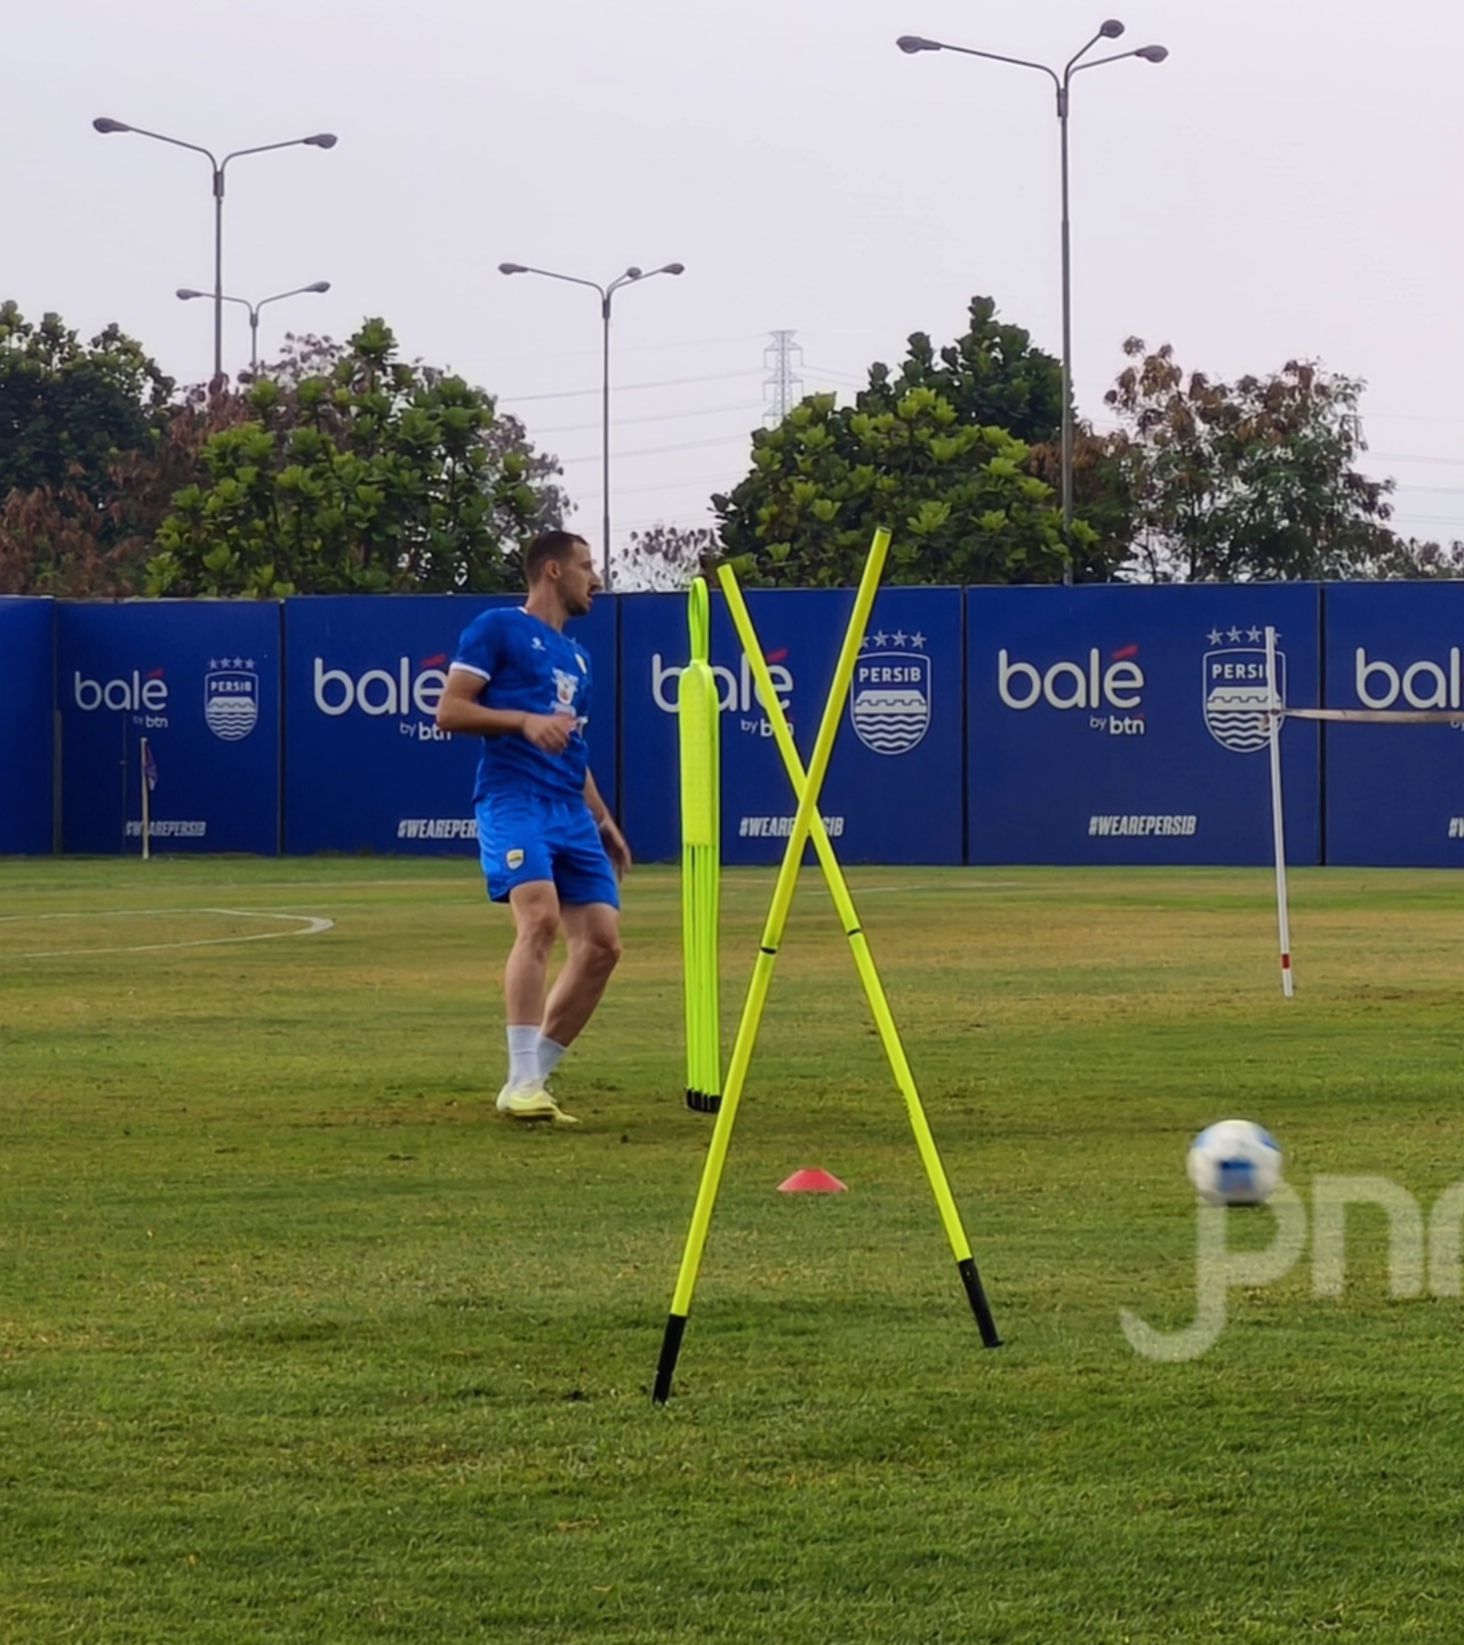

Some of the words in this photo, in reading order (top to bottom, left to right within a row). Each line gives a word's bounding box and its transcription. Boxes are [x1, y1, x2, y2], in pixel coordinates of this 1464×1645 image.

[858, 666, 922, 683] PERSIB
[998, 644, 1144, 710] balé
[1212, 663, 1268, 680] PERSI
[74, 667, 168, 711] balé
[210, 681, 252, 692] PERSIB
[145, 715, 168, 728] btn
[400, 721, 417, 737] by
[740, 718, 758, 735] by
[1089, 715, 1106, 731] by
[1109, 715, 1145, 735] btn
[1088, 815, 1197, 836] #WEAREPERSIB
